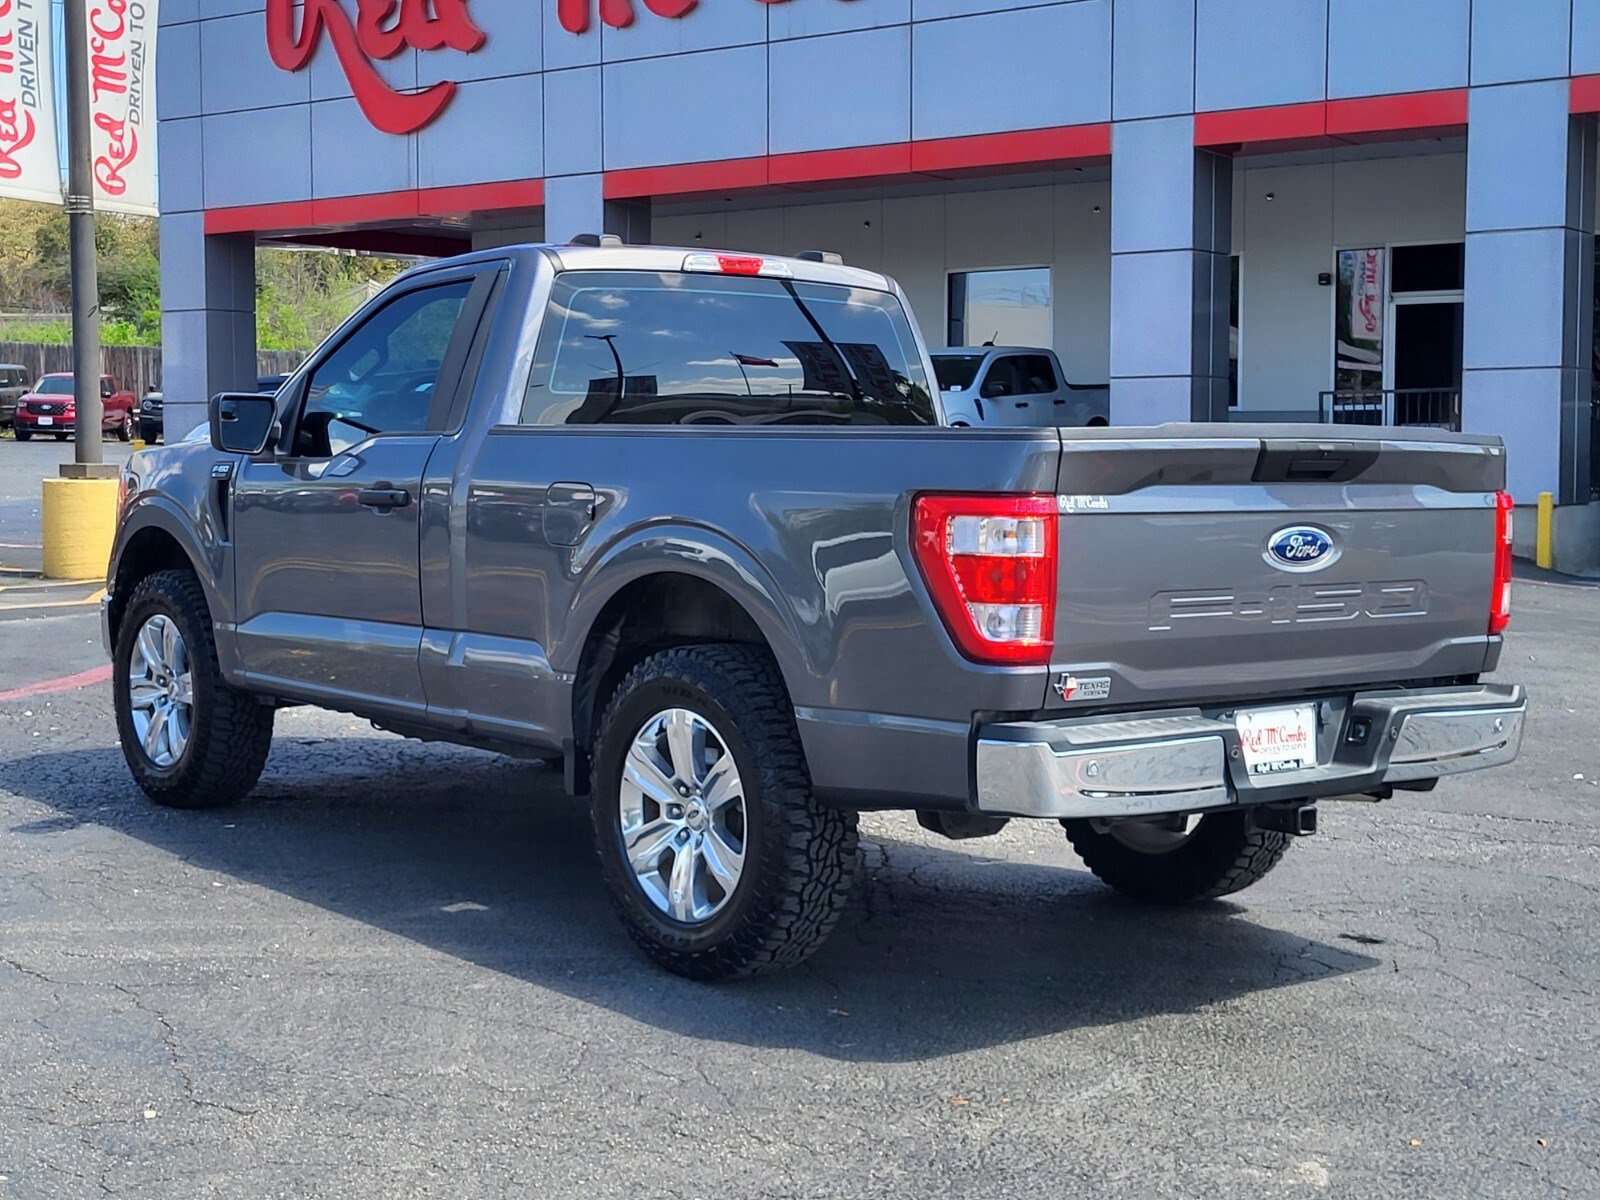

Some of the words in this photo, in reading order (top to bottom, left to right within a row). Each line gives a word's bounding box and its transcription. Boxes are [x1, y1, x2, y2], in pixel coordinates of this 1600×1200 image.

[129, 2, 146, 31] TO
[17, 18, 37, 109] DRIVEN
[129, 39, 142, 126] DRIVEN
[94, 112, 138, 196] Red
[1286, 534, 1321, 558] Ford
[1149, 578, 1429, 632] F-150
[1080, 681, 1109, 690] TEXAS
[1240, 728, 1262, 752] Red
